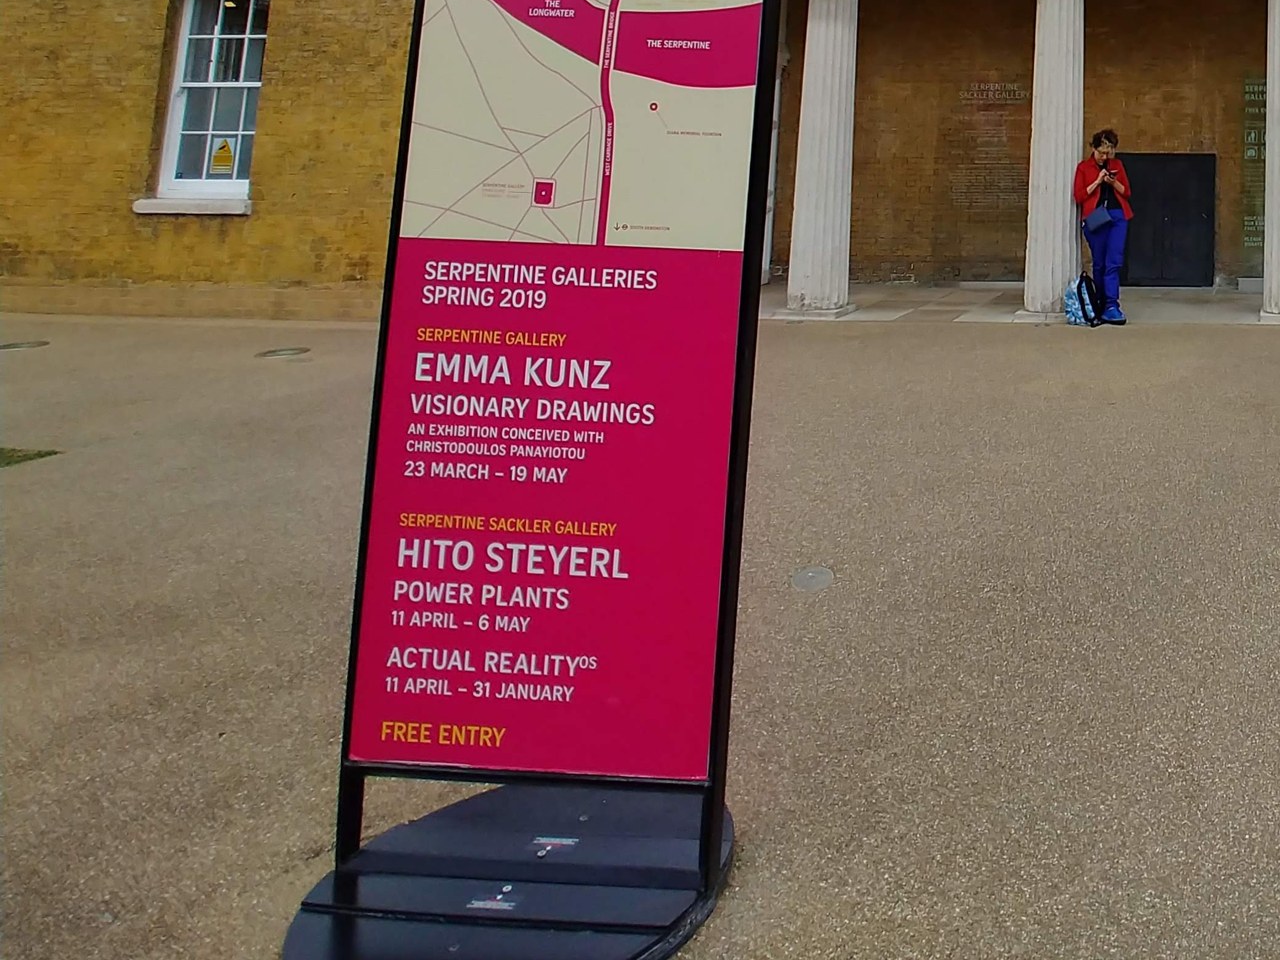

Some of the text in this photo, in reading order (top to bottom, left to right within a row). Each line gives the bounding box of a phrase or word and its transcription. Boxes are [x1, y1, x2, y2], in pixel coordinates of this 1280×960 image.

[528, 8, 575, 17] LONGWATER
[545, 0, 560, 8] THE
[646, 39, 711, 50] THE SERPENTINE
[959, 91, 1030, 99] SACKLER GALLERY
[424, 261, 658, 290] SERPENTINE GALLERIES
[421, 285, 547, 309] SPRING 2019
[416, 328, 567, 348] SERPENTINE GALLERY
[414, 352, 612, 390] EMMA KUNZ
[410, 393, 655, 425] VISIONARY DRAWINGS
[407, 423, 604, 444] AN EXHIBITION CONCEIVED WITH
[406, 440, 586, 460] CHRISTODOULOS PANAYIOTOU
[404, 461, 426, 478] 23
[430, 462, 490, 480] MARCH
[509, 465, 528, 482] 19
[532, 467, 568, 484] MAY
[399, 513, 617, 536] SERPENTINE SACKLER GALLERY
[397, 538, 629, 580] HITO STEYERL
[393, 580, 570, 610] POWER PLANTS
[391, 610, 406, 626] 11
[409, 611, 458, 630] APRIL
[478, 614, 489, 631] 6
[494, 616, 531, 633] MAY
[386, 647, 476, 672] ACTUAL
[385, 677, 399, 693] 11
[403, 678, 453, 696] APRIL
[472, 681, 491, 699] 31
[495, 683, 575, 703] JANUARY
[380, 721, 507, 747] FREE ENTRY
